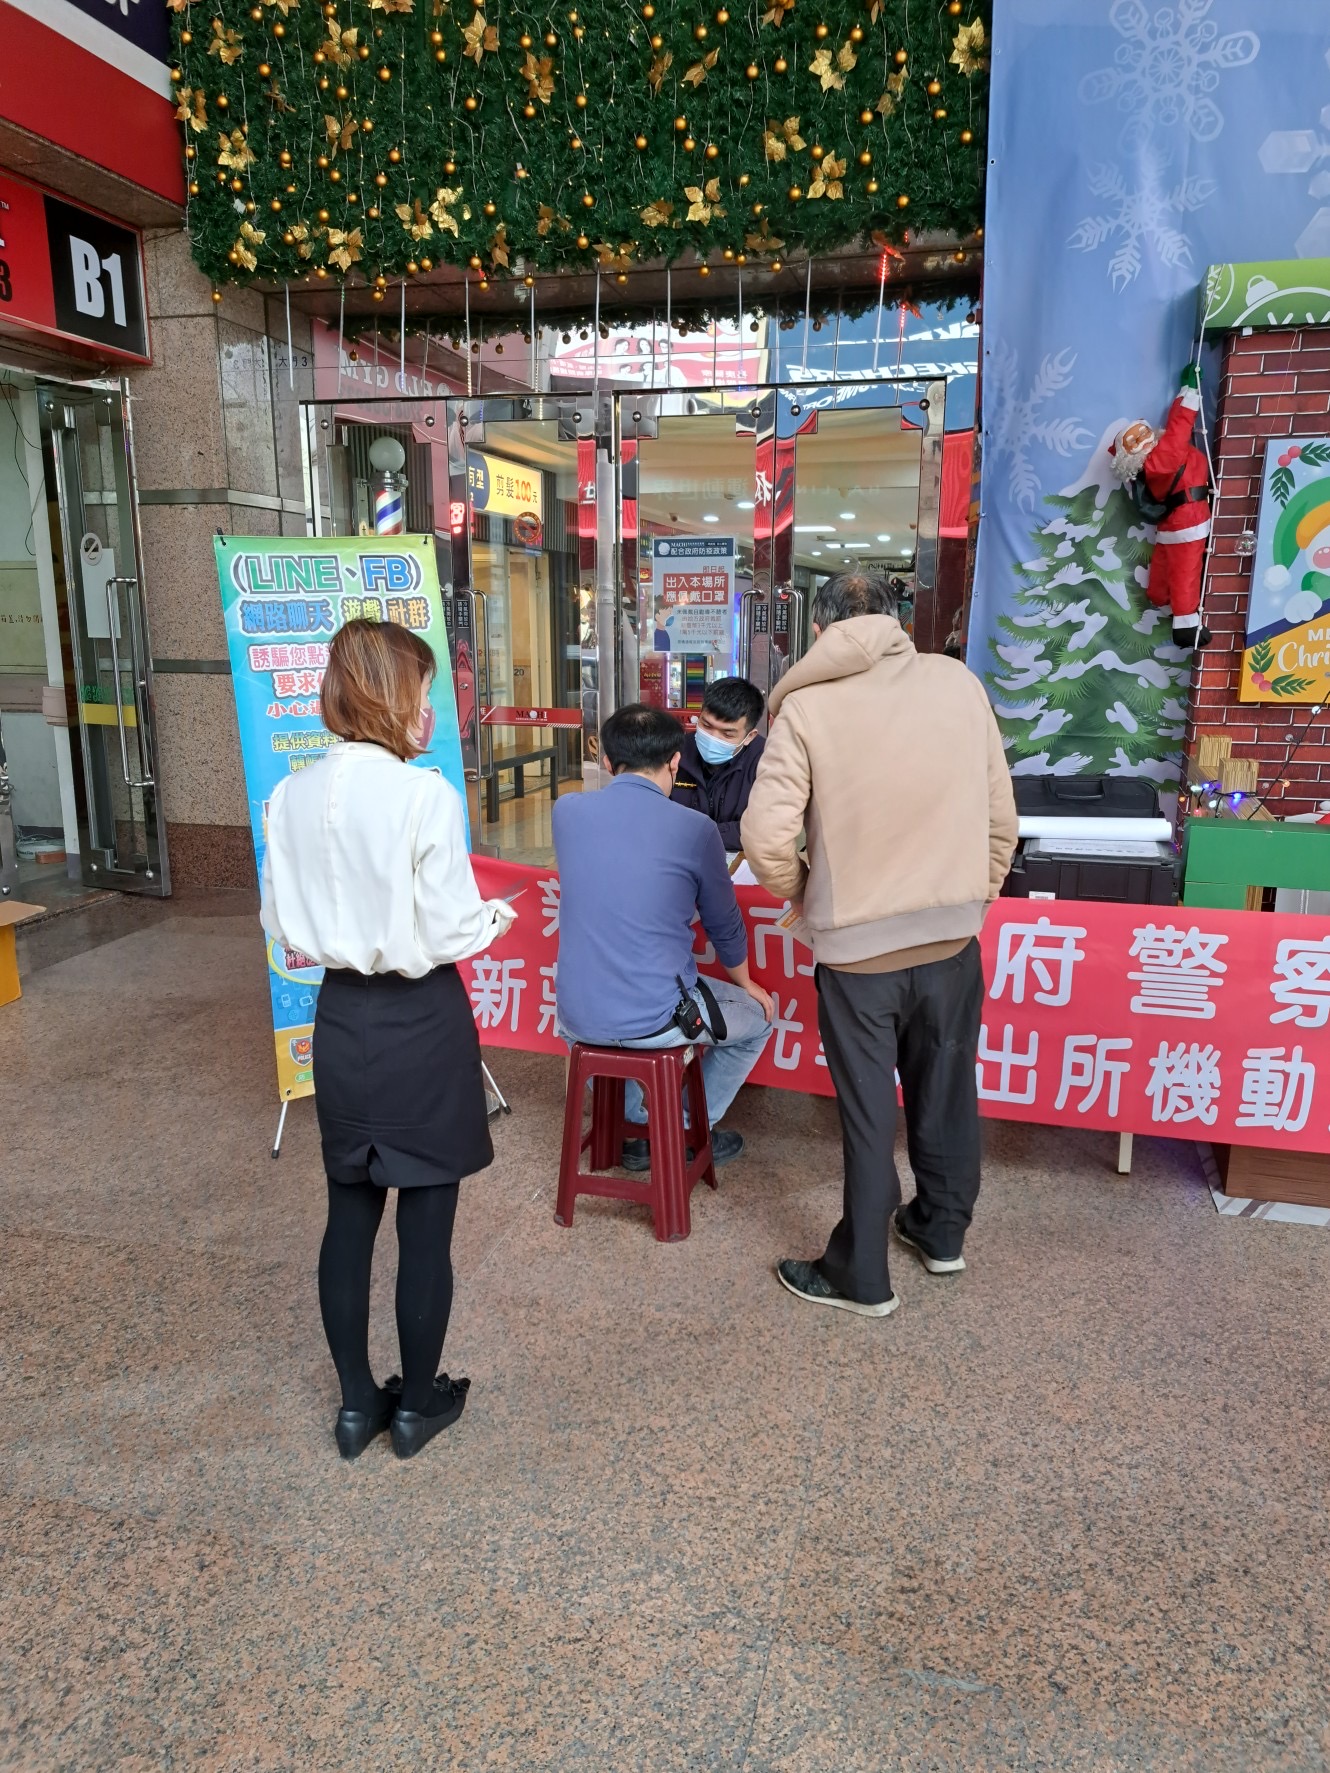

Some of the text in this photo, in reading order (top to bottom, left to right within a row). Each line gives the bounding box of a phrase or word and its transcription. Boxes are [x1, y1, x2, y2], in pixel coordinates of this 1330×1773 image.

[69, 234, 127, 328] B1
[301, 356, 308, 367] 3
[671, 547, 727, 556] 配合政府防疫政策
[666, 576, 726, 589] 出入本場所
[241, 599, 334, 632] 網路聊天
[386, 597, 431, 629] 社群
[272, 731, 345, 752] 提供資料
